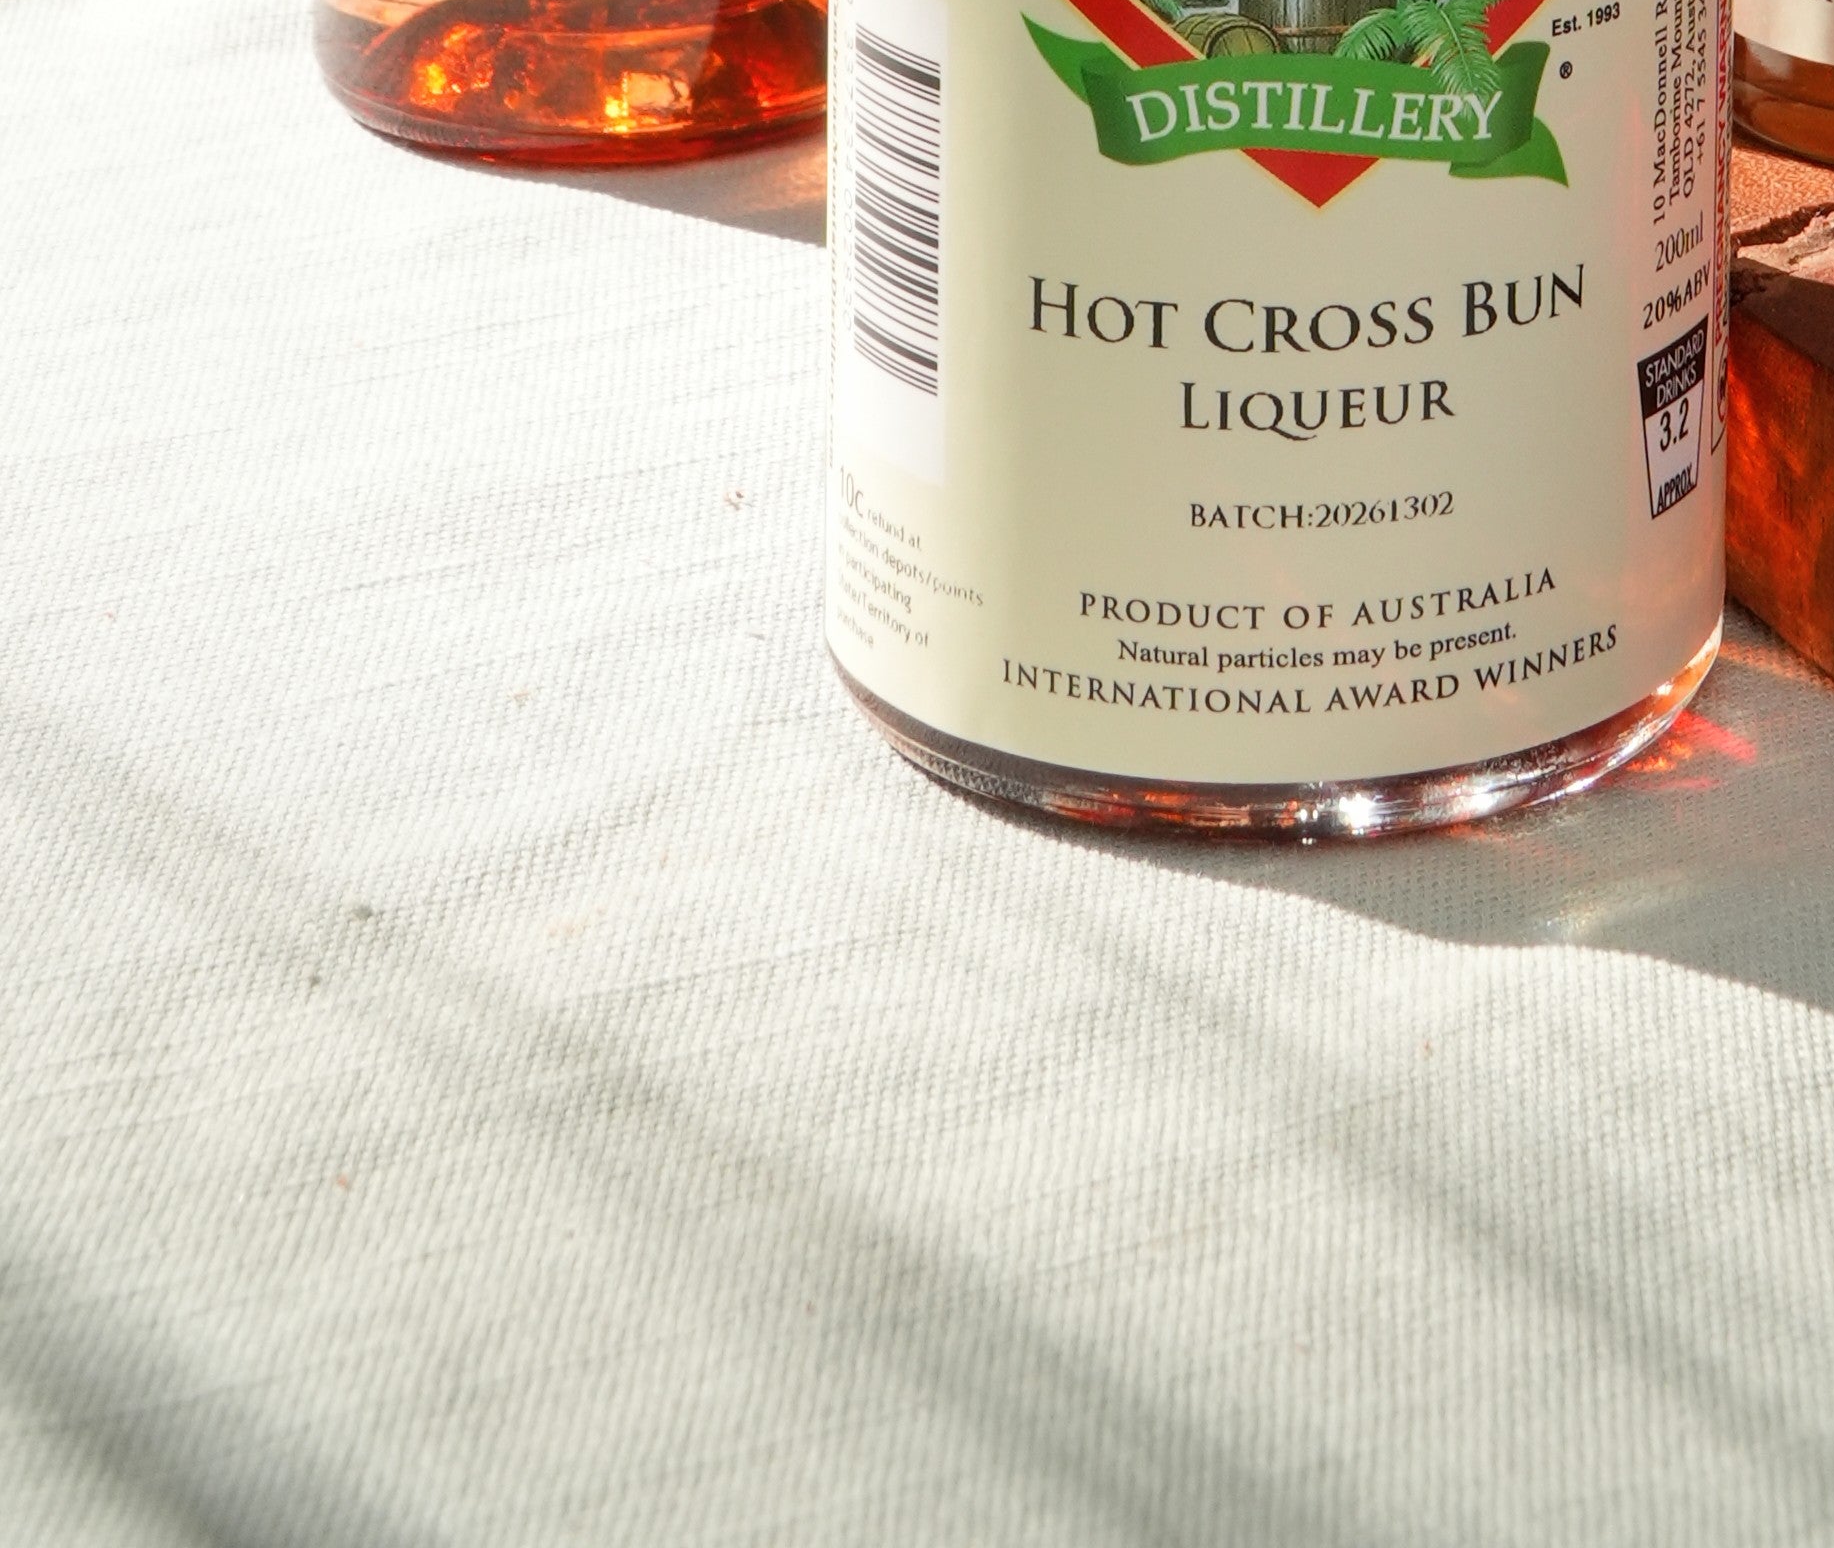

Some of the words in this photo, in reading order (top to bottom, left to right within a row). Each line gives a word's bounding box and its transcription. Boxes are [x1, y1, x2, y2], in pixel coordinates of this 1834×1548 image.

[1551, 14, 1582, 37] Est.
[1586, 1, 1621, 28] 1993
[1697, 29, 1707, 87] 5545
[1125, 80, 1503, 144] DISTILLERY
[1653, 25, 1668, 188] MacDonnell
[1684, 59, 1697, 128] 4272,
[1696, 98, 1706, 112] 7
[1669, 76, 1682, 206] Tamborine
[1683, 136, 1695, 199] QLD
[1696, 119, 1706, 165] +61
[1653, 194, 1667, 225] 10
[1643, 258, 1711, 330] 20%ABV
[1645, 327, 1705, 389] STANDARD
[1656, 359, 1697, 408] DRINKS
[1659, 396, 1690, 452] 3.2
[1189, 490, 1455, 530] BATCH:20261302
[1078, 591, 1266, 631] PRODUCT
[1282, 603, 1336, 631] OF
[1351, 566, 1557, 628] AUSTRALIA
[1001, 659, 1312, 714] INTERNATIONAL
[1324, 673, 1461, 713] AWARD
[1473, 624, 1619, 692] WINNERS
[1116, 639, 1210, 669] Natural
[1216, 646, 1326, 674] particles
[1332, 647, 1387, 671] may
[1393, 638, 1424, 661] be
[1429, 620, 1519, 662] present.
